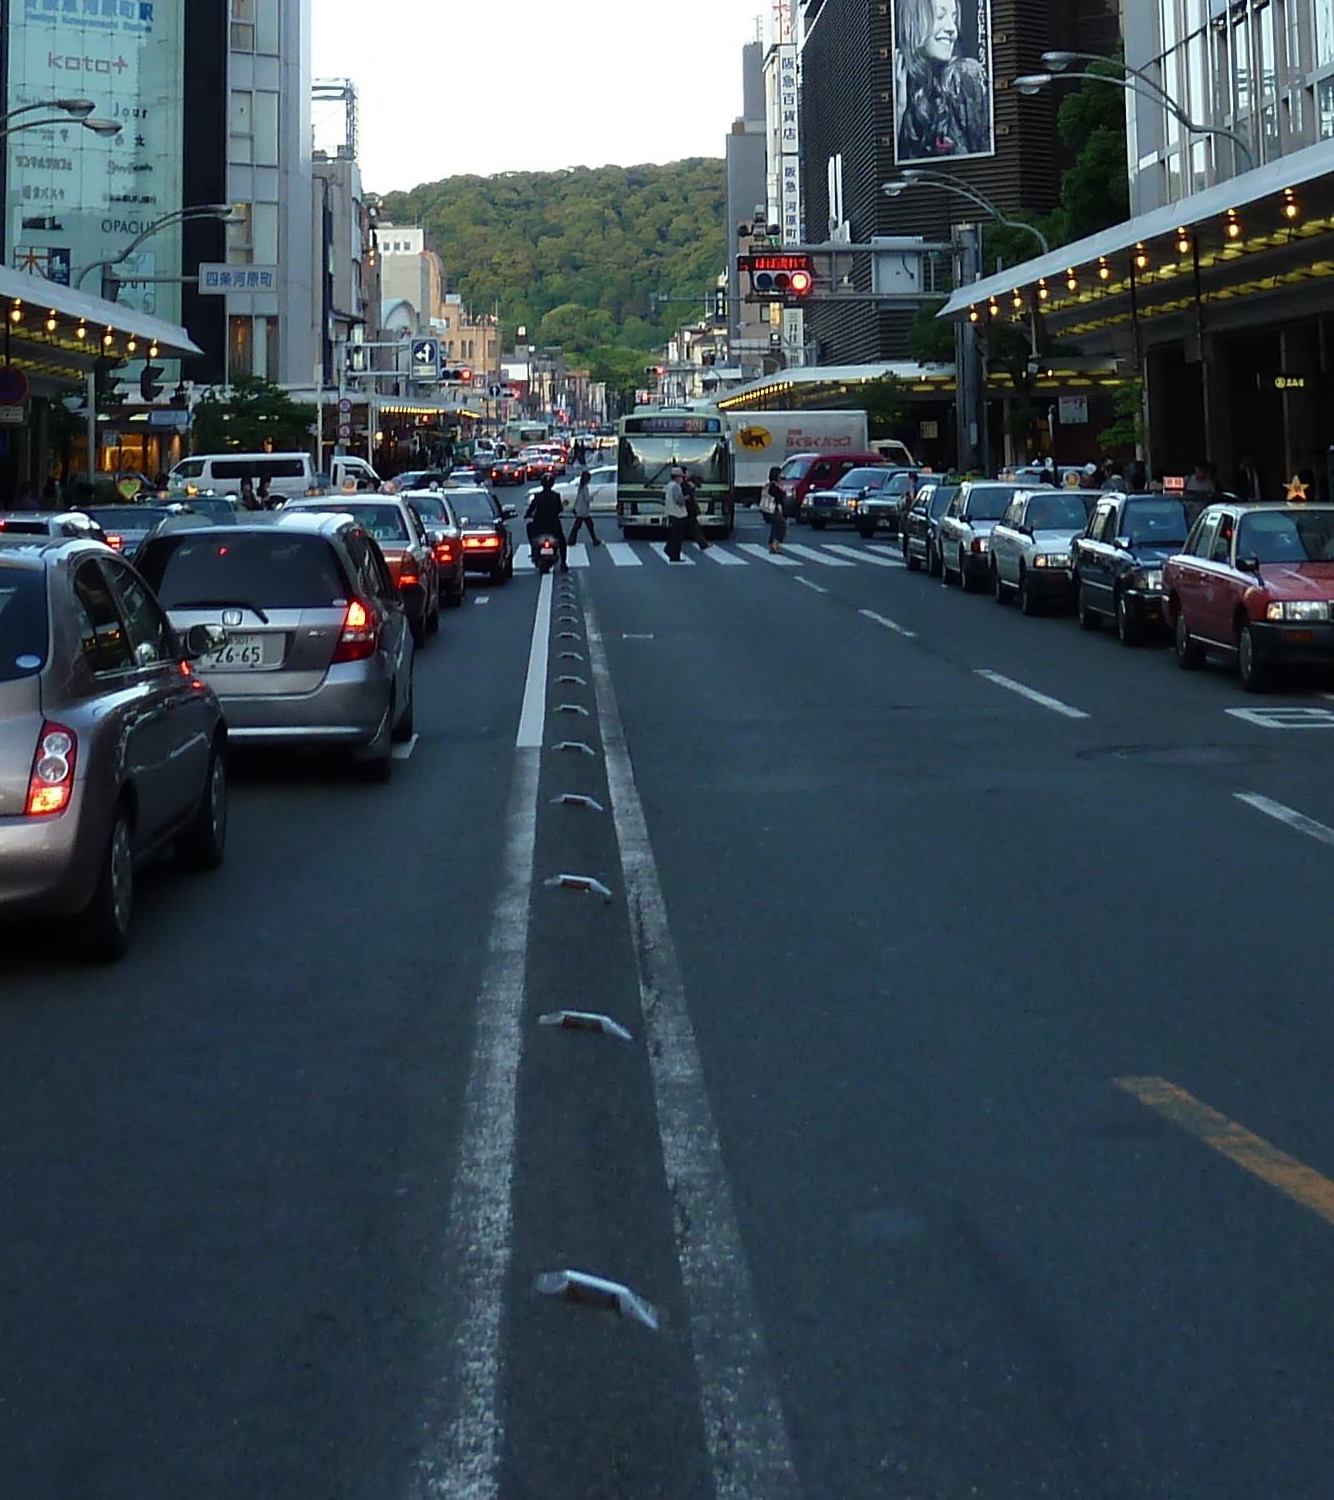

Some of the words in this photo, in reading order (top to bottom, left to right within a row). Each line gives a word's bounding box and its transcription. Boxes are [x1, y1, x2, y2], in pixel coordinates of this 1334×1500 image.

[781, 55, 797, 141] 阪急百貨店
[784, 166, 797, 194] 阪急
[205, 270, 274, 288] 四条河原町
